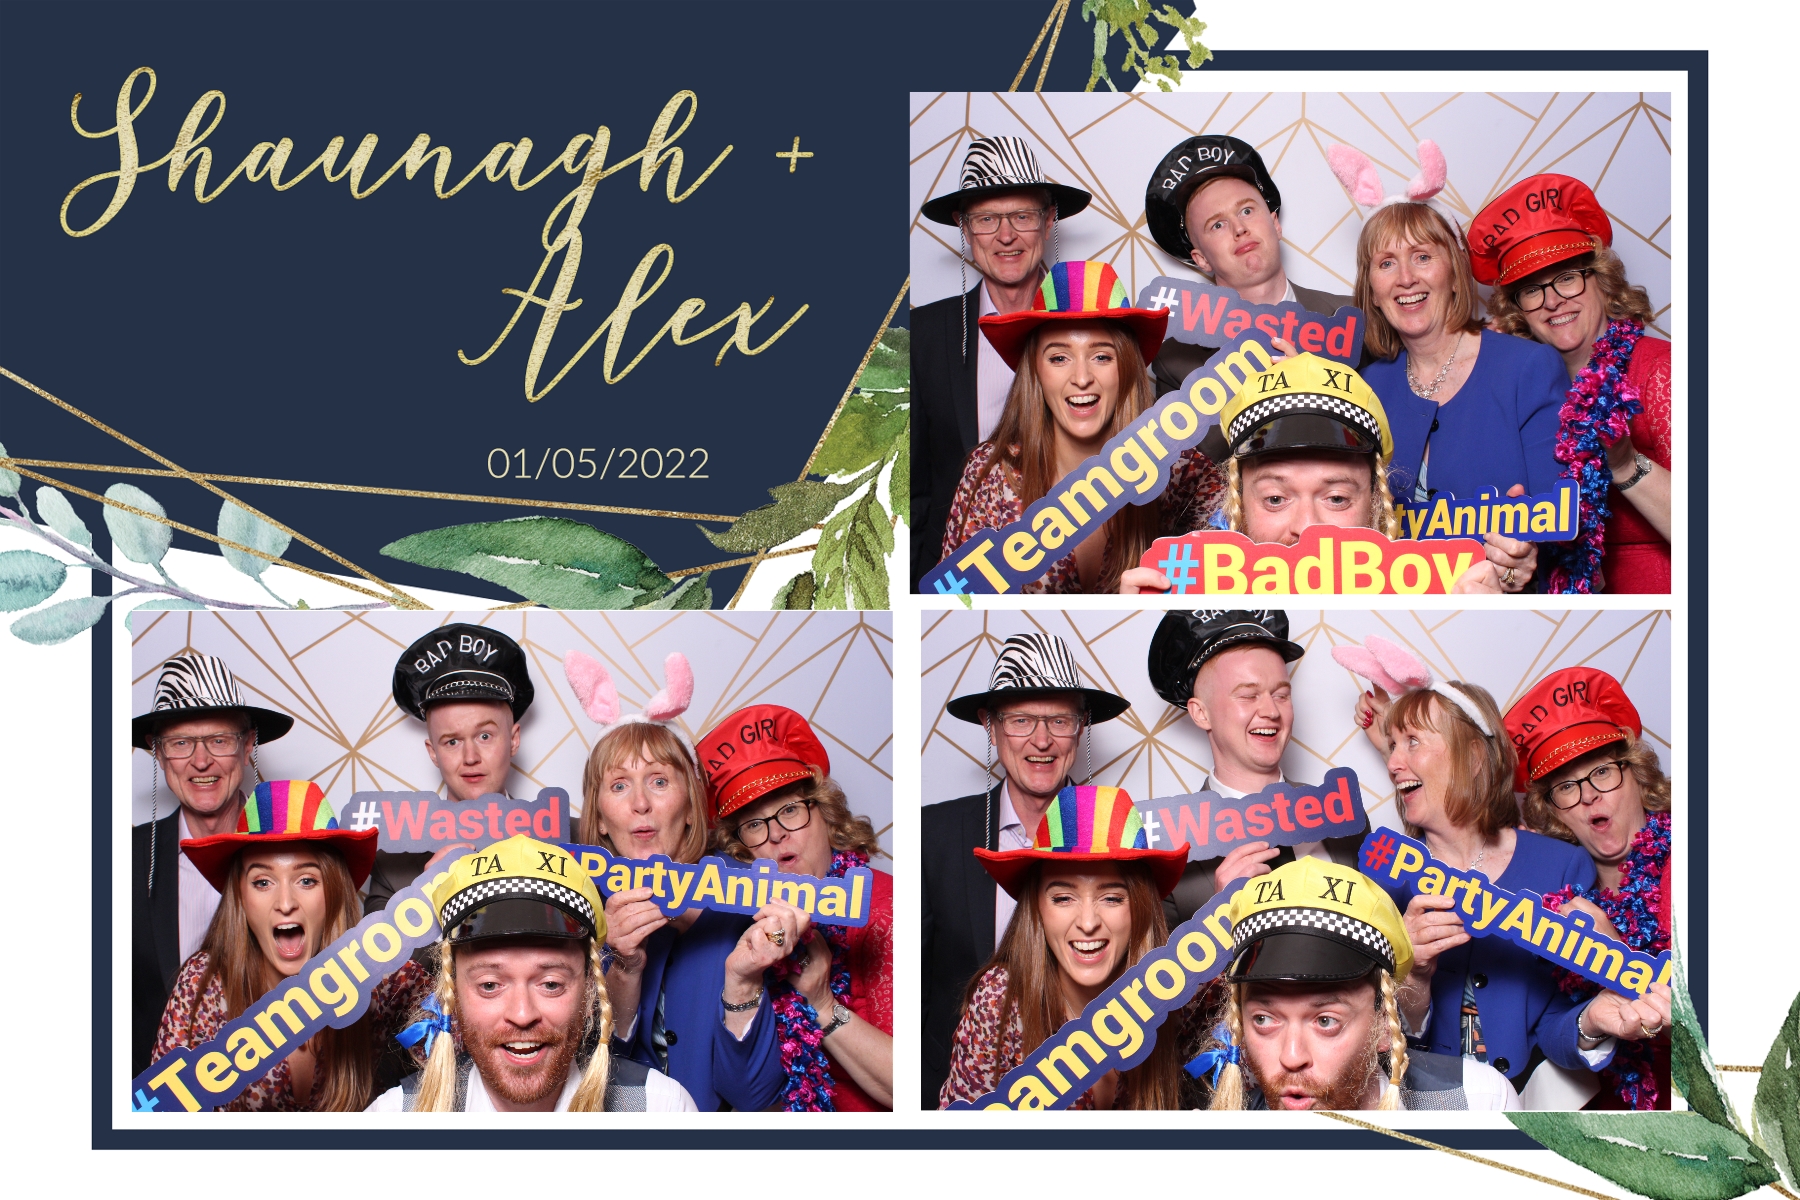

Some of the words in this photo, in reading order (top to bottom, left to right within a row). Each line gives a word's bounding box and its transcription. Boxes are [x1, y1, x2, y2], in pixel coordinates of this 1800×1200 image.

[1162, 155, 1192, 190] BAD
[1197, 146, 1235, 165] BOY
[1526, 188, 1563, 212] GIRL
[414, 639, 452, 674] BAD
[459, 634, 498, 662] BOY
[1553, 681, 1590, 707] GIRL
[706, 742, 736, 779] AD
[740, 718, 779, 745] GIRL
[350, 796, 561, 841] #Wasted
[569, 850, 865, 919] PartyAnimal
[983, 889, 1244, 1110] amgroo
